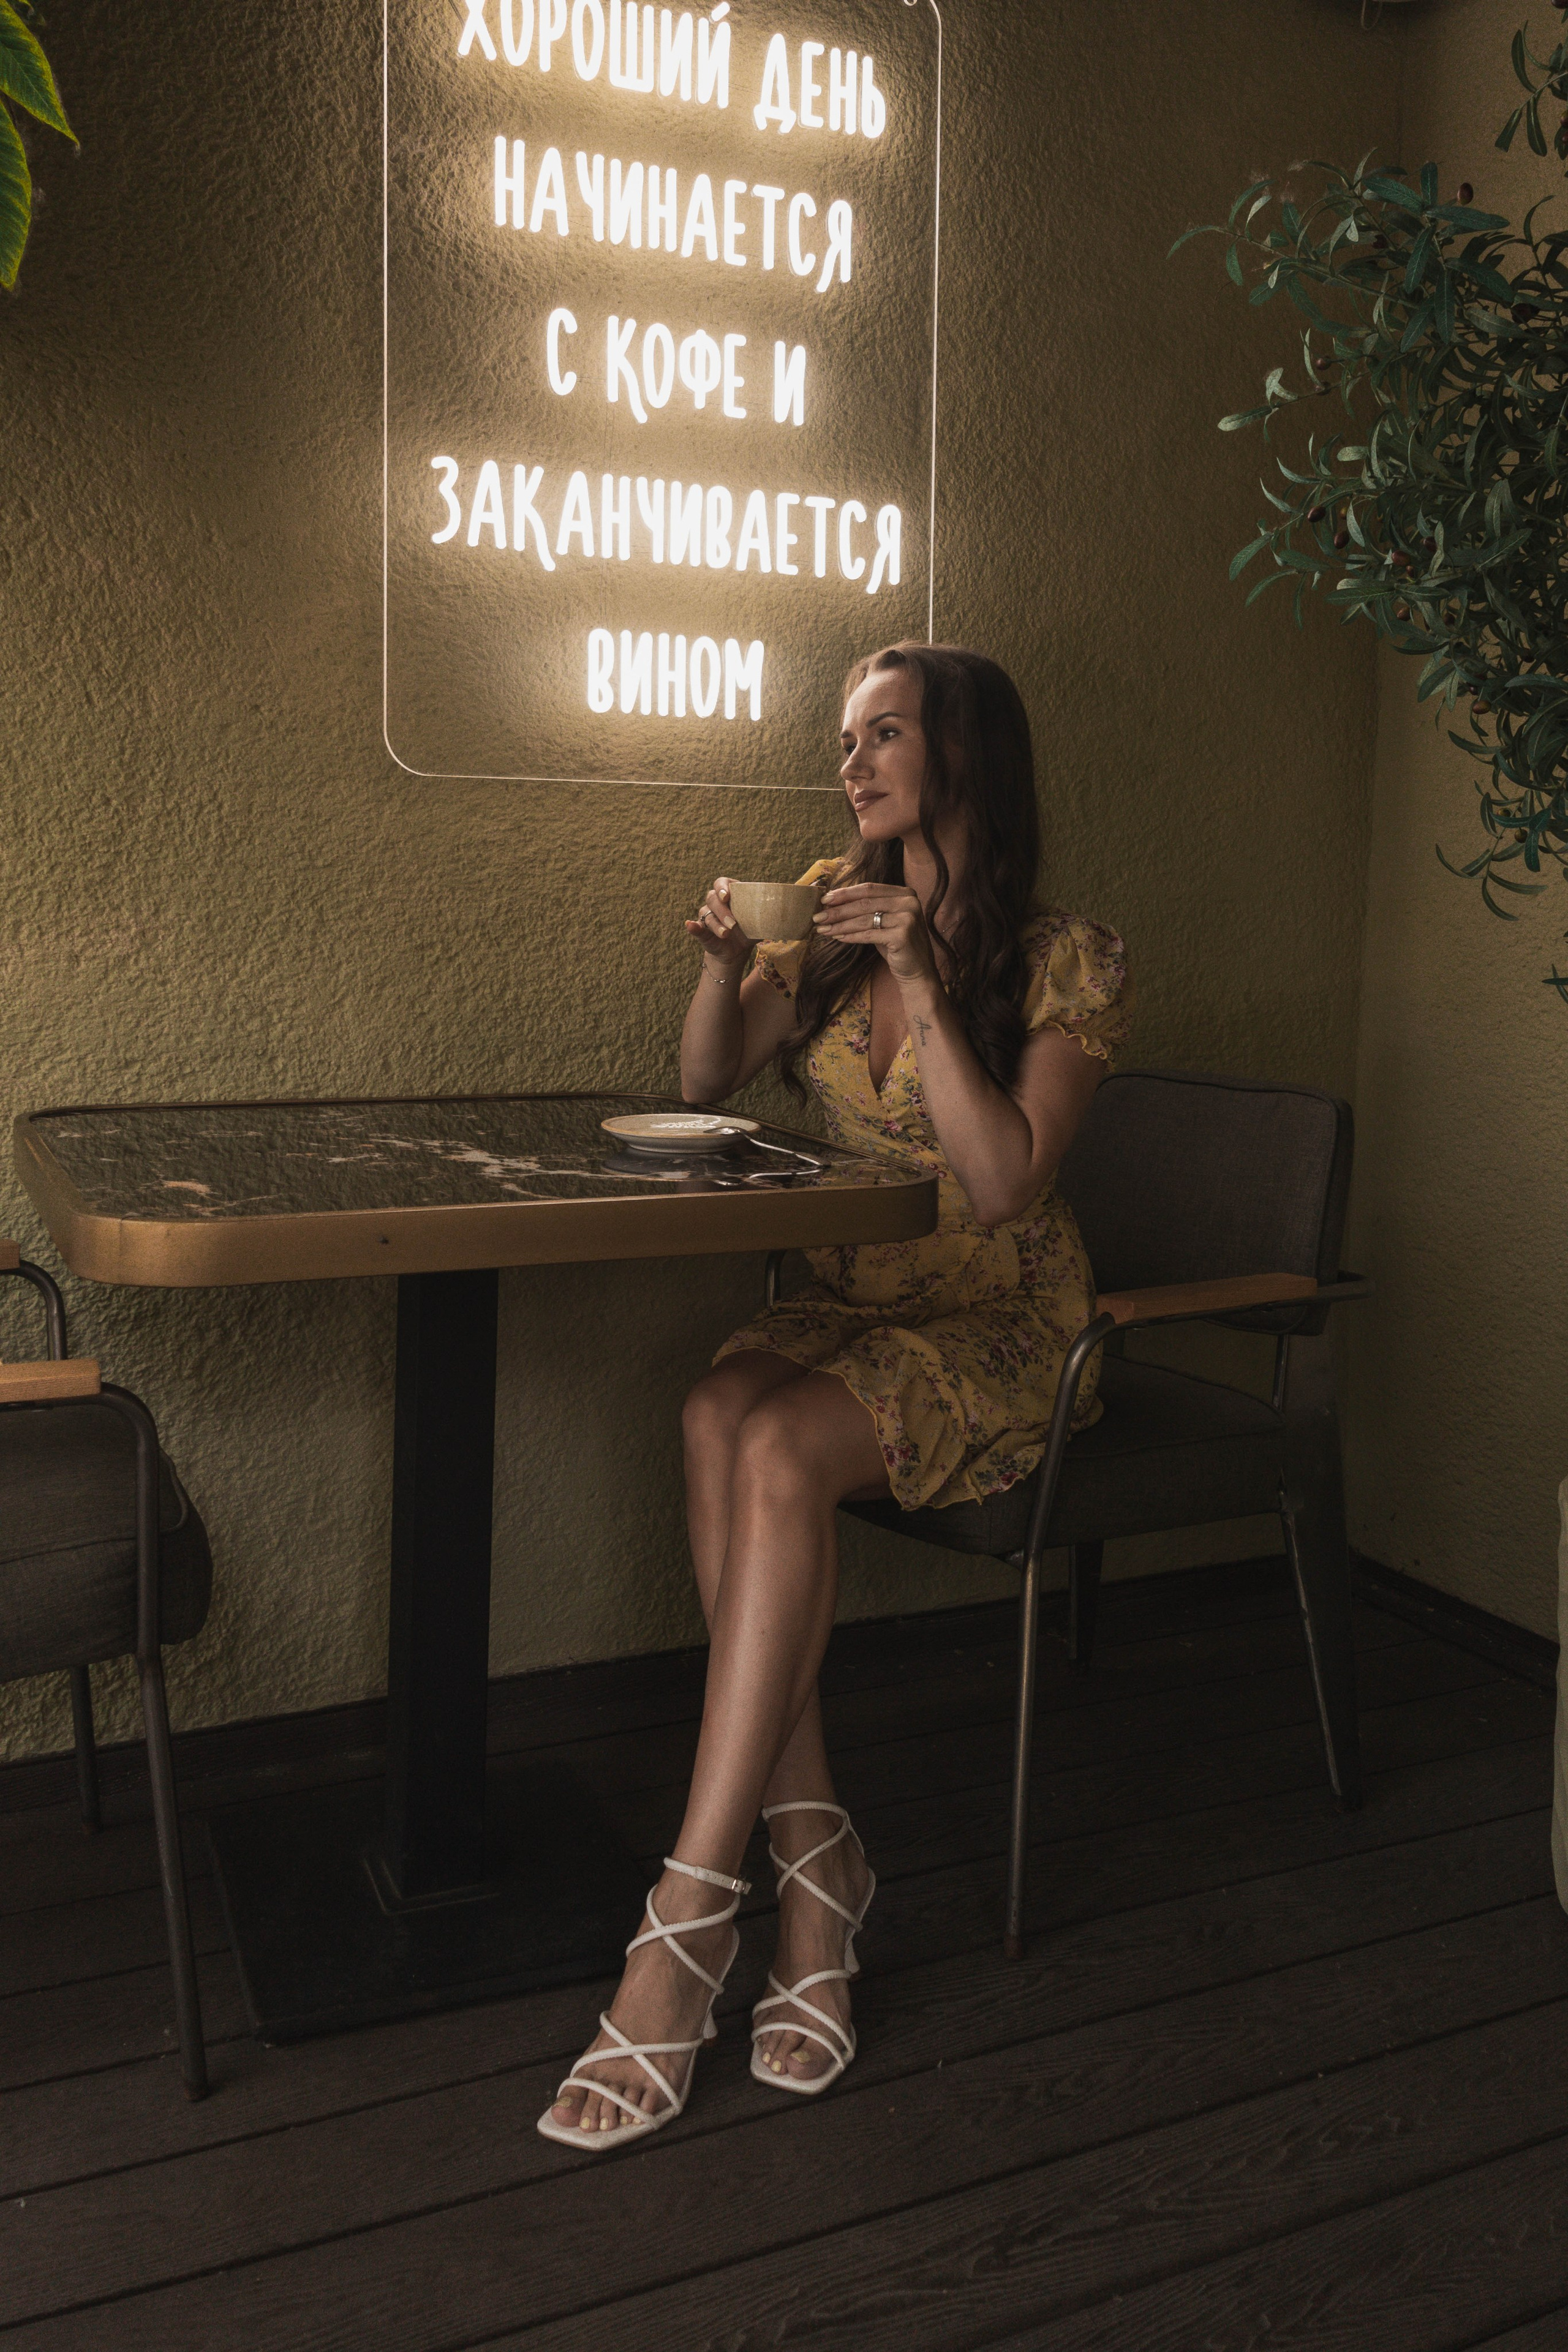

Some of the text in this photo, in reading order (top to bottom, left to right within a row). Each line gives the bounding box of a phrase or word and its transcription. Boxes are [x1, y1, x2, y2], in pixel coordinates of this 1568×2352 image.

[457, 0, 886, 139] ХОРОШИЙ ДЕНЬ
[494, 135, 853, 293] НАЧИНАЕТСЯ
[546, 307, 807, 426] С КОФЕ И
[431, 456, 902, 595] ЗАКАНЧИВАЕТСЯ
[587, 628, 765, 722] ВИНОМ
